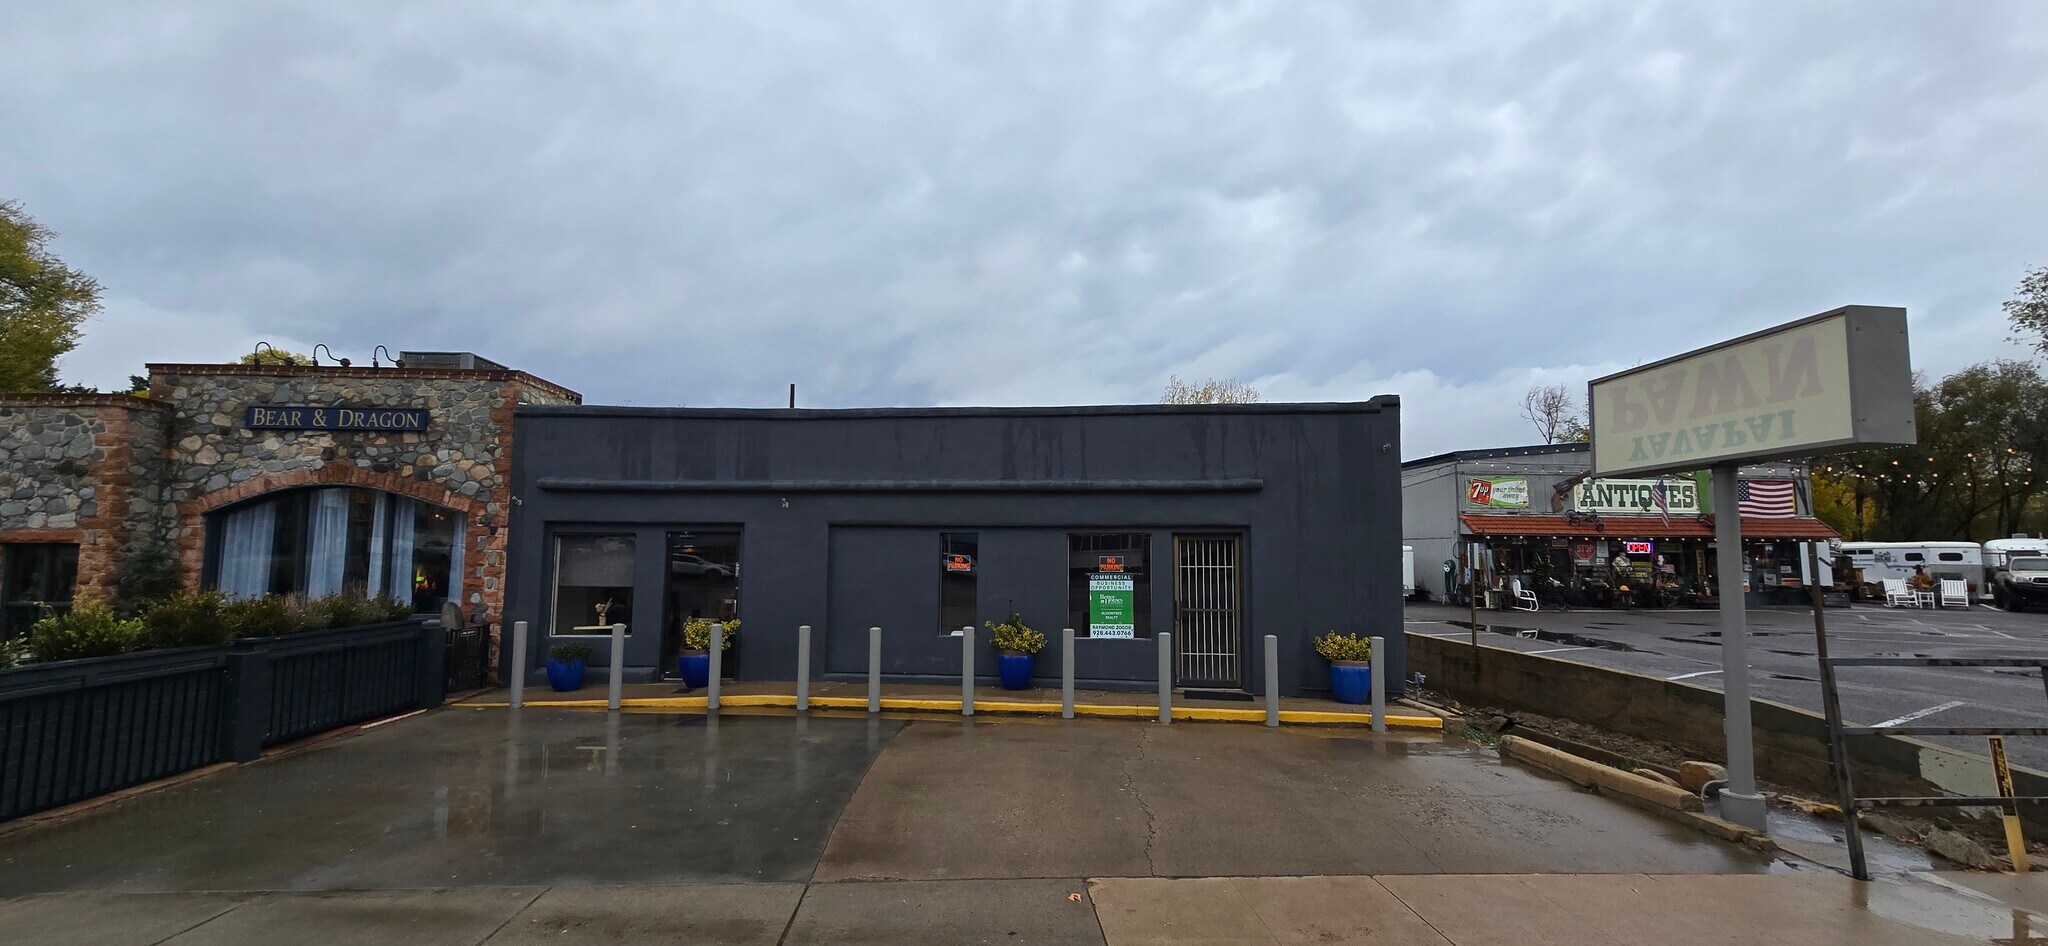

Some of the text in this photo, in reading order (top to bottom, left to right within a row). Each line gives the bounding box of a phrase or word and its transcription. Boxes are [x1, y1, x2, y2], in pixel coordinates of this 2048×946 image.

[252, 408, 420, 428] BEAR & DRAGON
[1580, 484, 1695, 512] ANTIQES
[1577, 544, 1594, 553] STOP
[1629, 543, 1649, 552] OPEN
